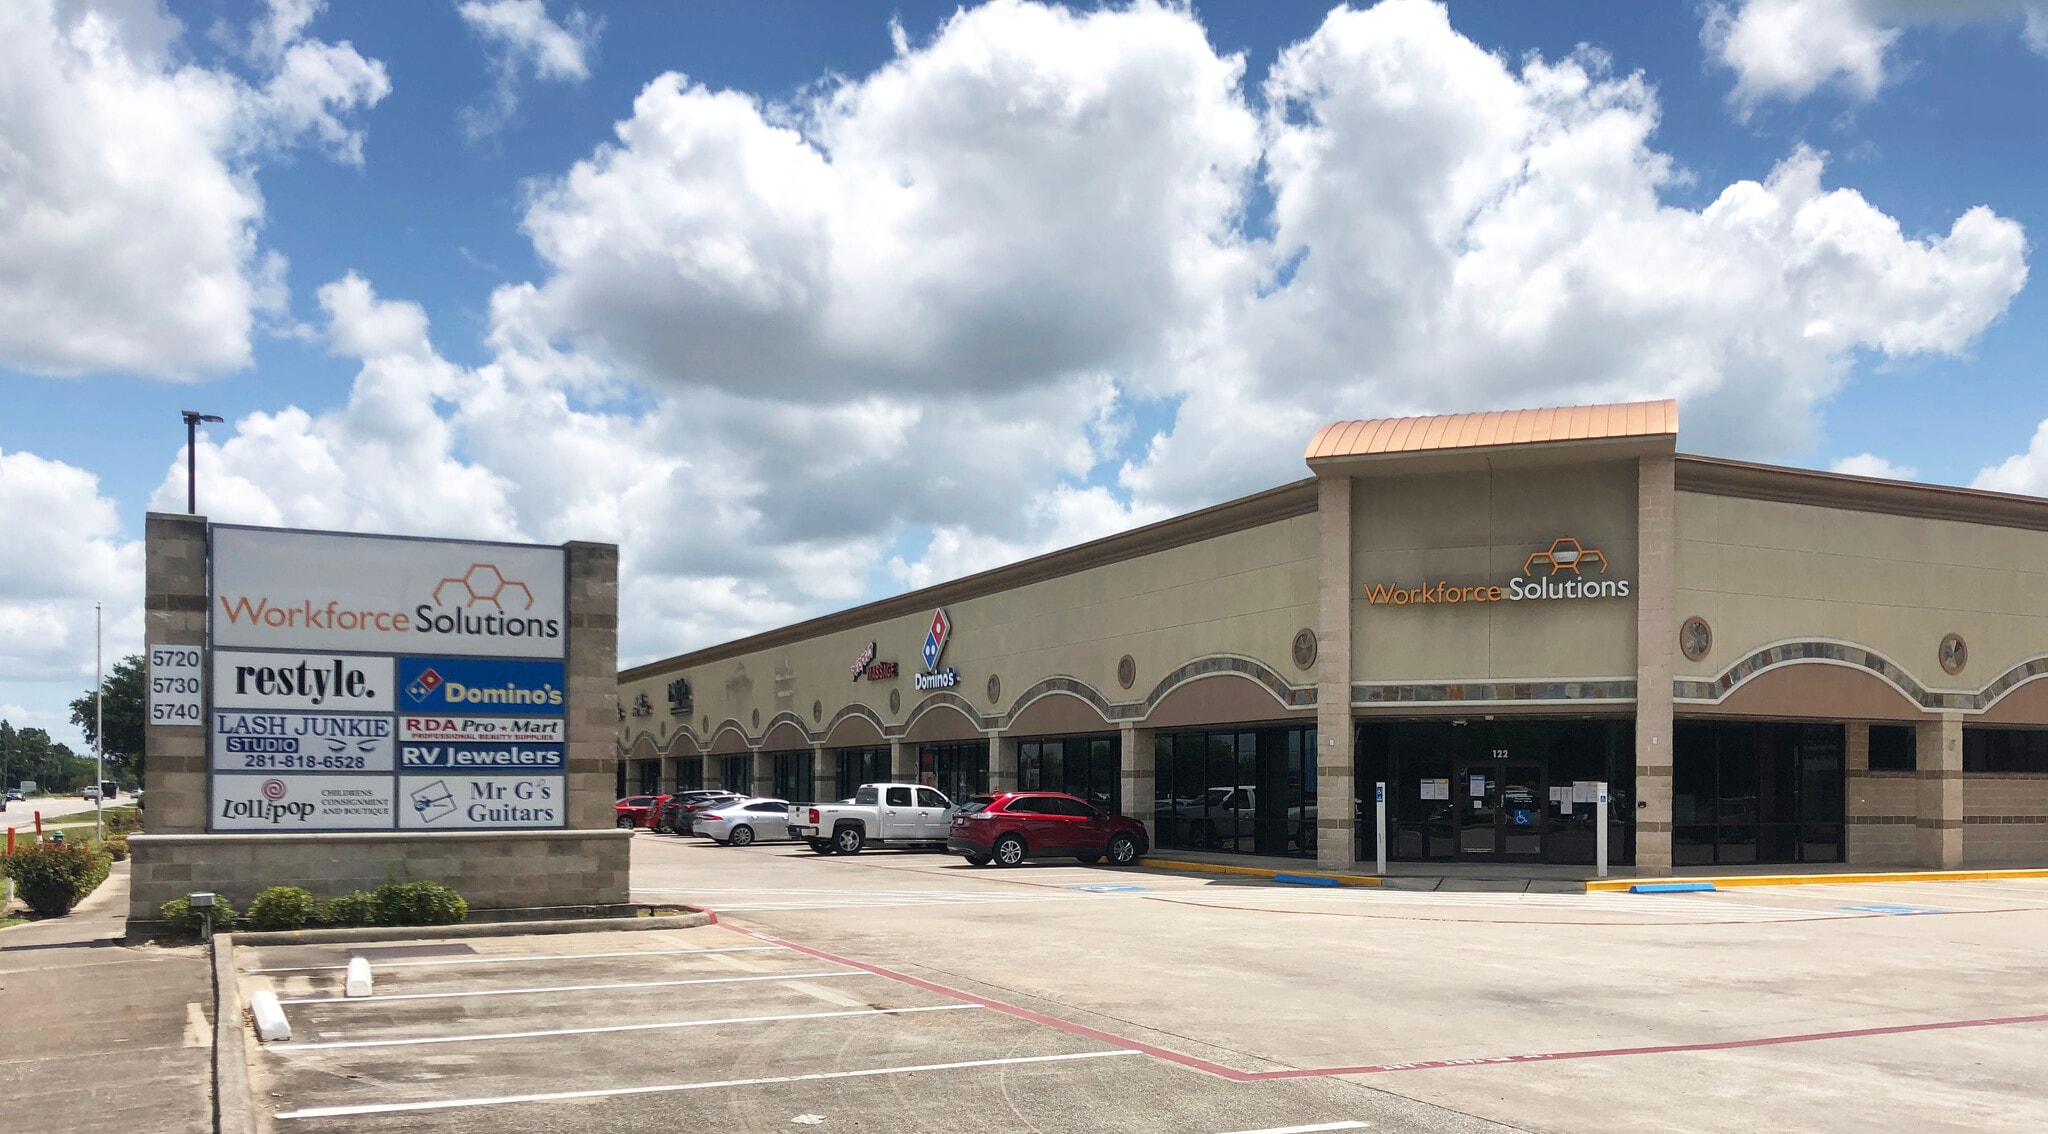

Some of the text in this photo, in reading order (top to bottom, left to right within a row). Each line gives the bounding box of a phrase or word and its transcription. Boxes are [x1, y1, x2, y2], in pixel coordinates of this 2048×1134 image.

[1364, 576, 1630, 605] Workforce Solutions
[219, 595, 560, 638] Workforce Solutions
[152, 650, 199, 667] 5720
[152, 677, 199, 694] 5730
[234, 659, 375, 705] restyle.
[915, 668, 954, 690] Domino's
[444, 682, 563, 705] Domino's
[153, 703, 200, 720] 5740
[217, 715, 390, 738] LASH JUNKIE
[405, 719, 560, 734] RDA Pro Mart
[228, 737, 297, 752] STUDIO
[1492, 749, 1509, 759] 122
[244, 755, 366, 769] 281-818-6528
[401, 746, 561, 767] RV Jewelers
[470, 781, 507, 800] Mr
[467, 803, 555, 823] Guitars
